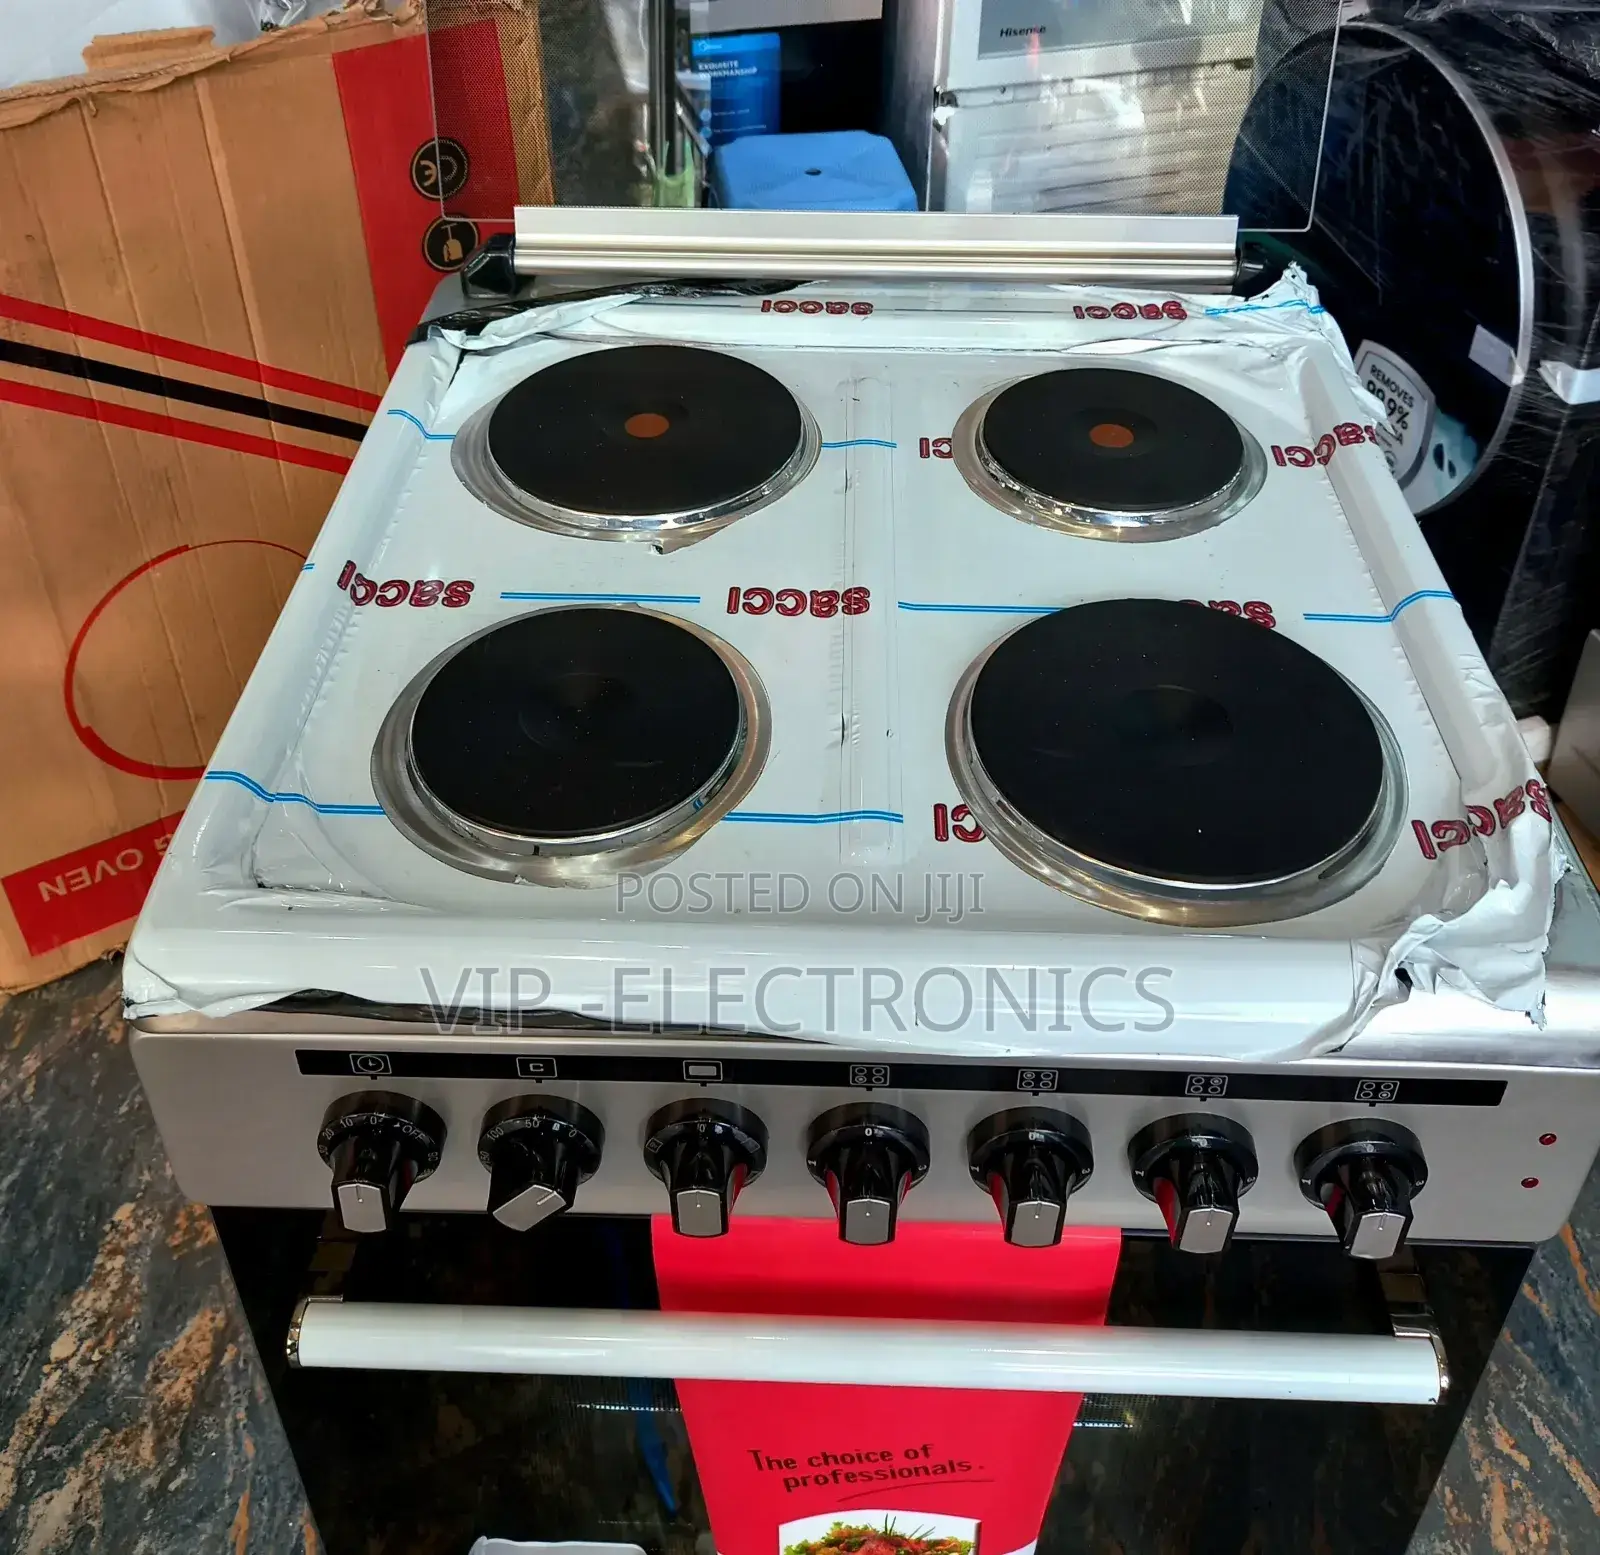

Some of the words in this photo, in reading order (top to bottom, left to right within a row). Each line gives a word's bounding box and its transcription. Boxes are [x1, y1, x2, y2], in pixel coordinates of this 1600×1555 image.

[1000, 25, 1047, 38] Hisense
[1370, 364, 1415, 409] REMOVES
[337, 560, 475, 608] sacci
[727, 586, 870, 618] sacci
[37, 848, 144, 903] OVEN
[340, 1117, 354, 1128] 10
[525, 1119, 540, 1129] 50
[322, 1127, 335, 1141] 20
[402, 1124, 426, 1142] OFF
[486, 1126, 505, 1141] 100
[864, 1127, 873, 1136] 0
[747, 1449, 798, 1472] The
[807, 1449, 893, 1469] choice
[904, 1443, 935, 1461] of
